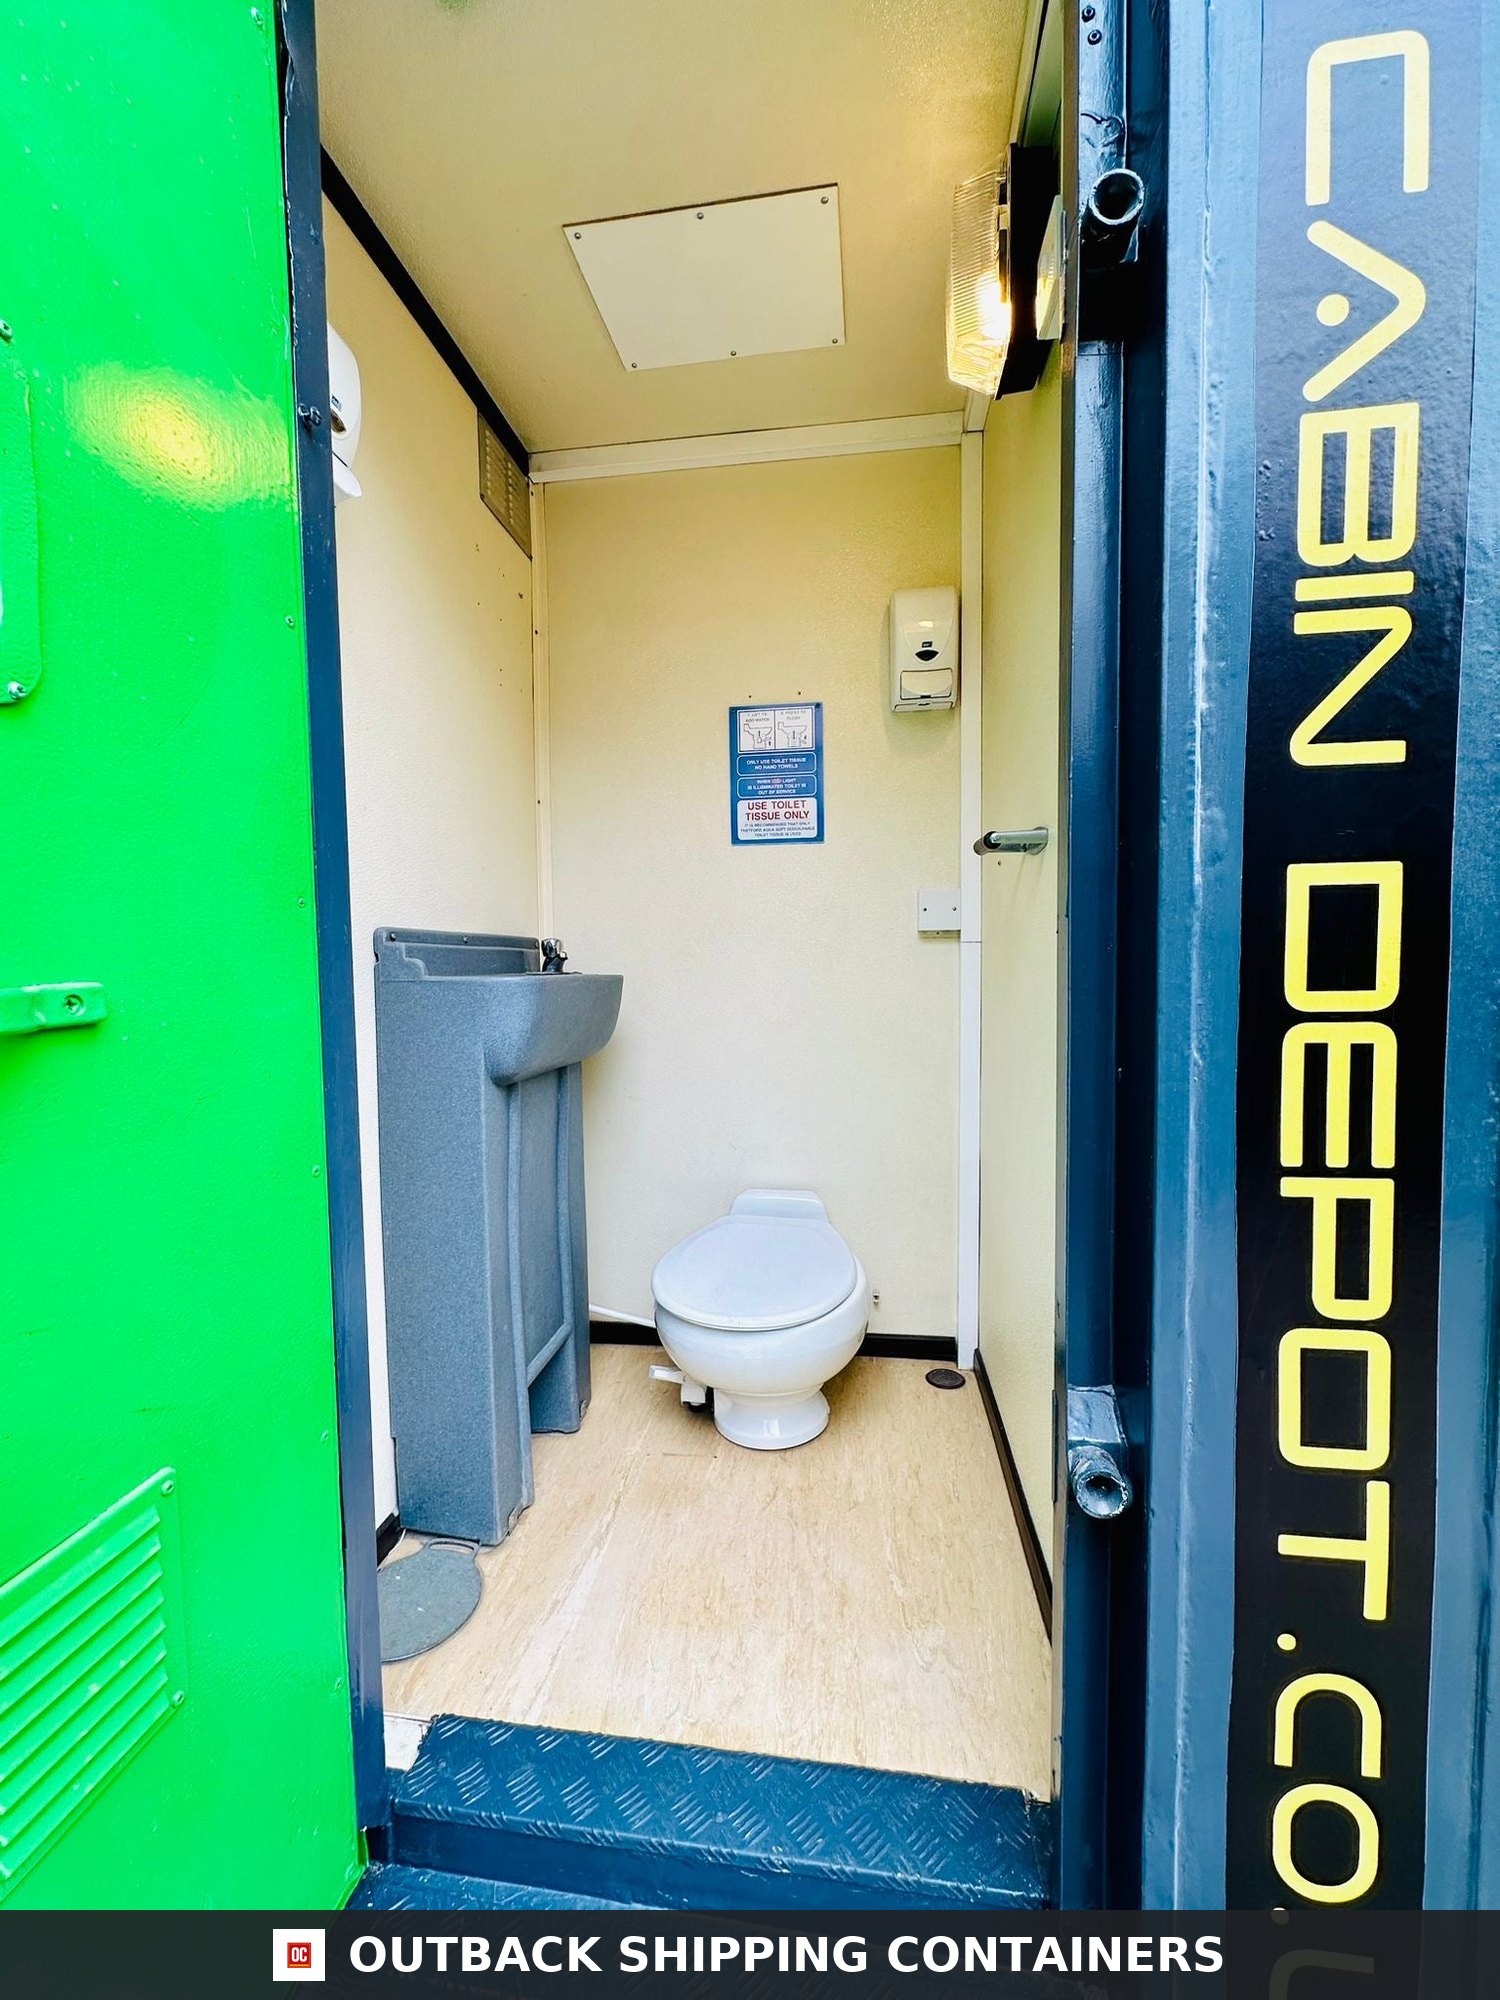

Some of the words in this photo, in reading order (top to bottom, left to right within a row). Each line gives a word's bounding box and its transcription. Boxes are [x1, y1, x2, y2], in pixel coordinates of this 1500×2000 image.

[1289, 30, 1430, 766] CABIN
[747, 802, 767, 810] USE
[772, 800, 806, 809] TOILET
[746, 812, 780, 821] TISSUE
[784, 810, 810, 819] ONLY
